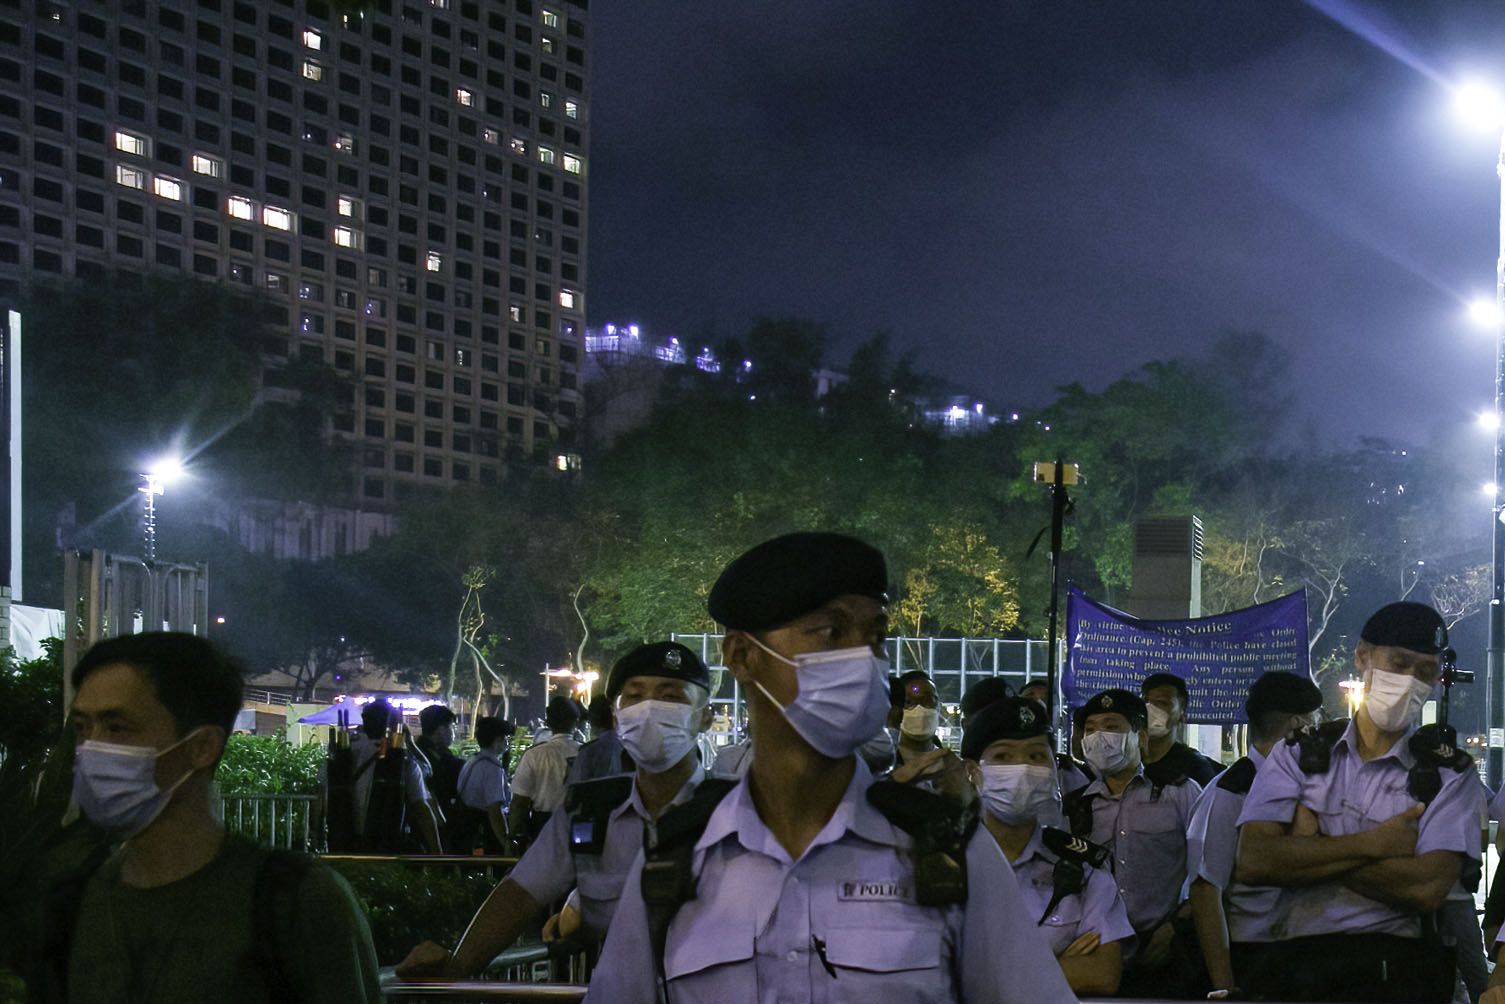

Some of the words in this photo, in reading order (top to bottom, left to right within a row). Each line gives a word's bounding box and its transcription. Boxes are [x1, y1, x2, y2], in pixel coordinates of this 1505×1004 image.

[1186, 622, 1232, 635] Notice
[1129, 636, 1156, 647] (Cap.
[1210, 640, 1240, 650] Police
[1244, 641, 1267, 650] have
[1271, 638, 1297, 650] closed
[1129, 649, 1165, 659] prevent
[1176, 650, 1226, 663] prohibited
[1230, 653, 1261, 664] public
[1263, 652, 1297, 662] meeting
[1106, 659, 1135, 670] taking
[1191, 664, 1211, 673] Any
[1221, 665, 1254, 675] person
[1263, 662, 1297, 672] without
[1211, 699, 1241, 709] Order
[1186, 711, 1237, 721] rosecuted.
